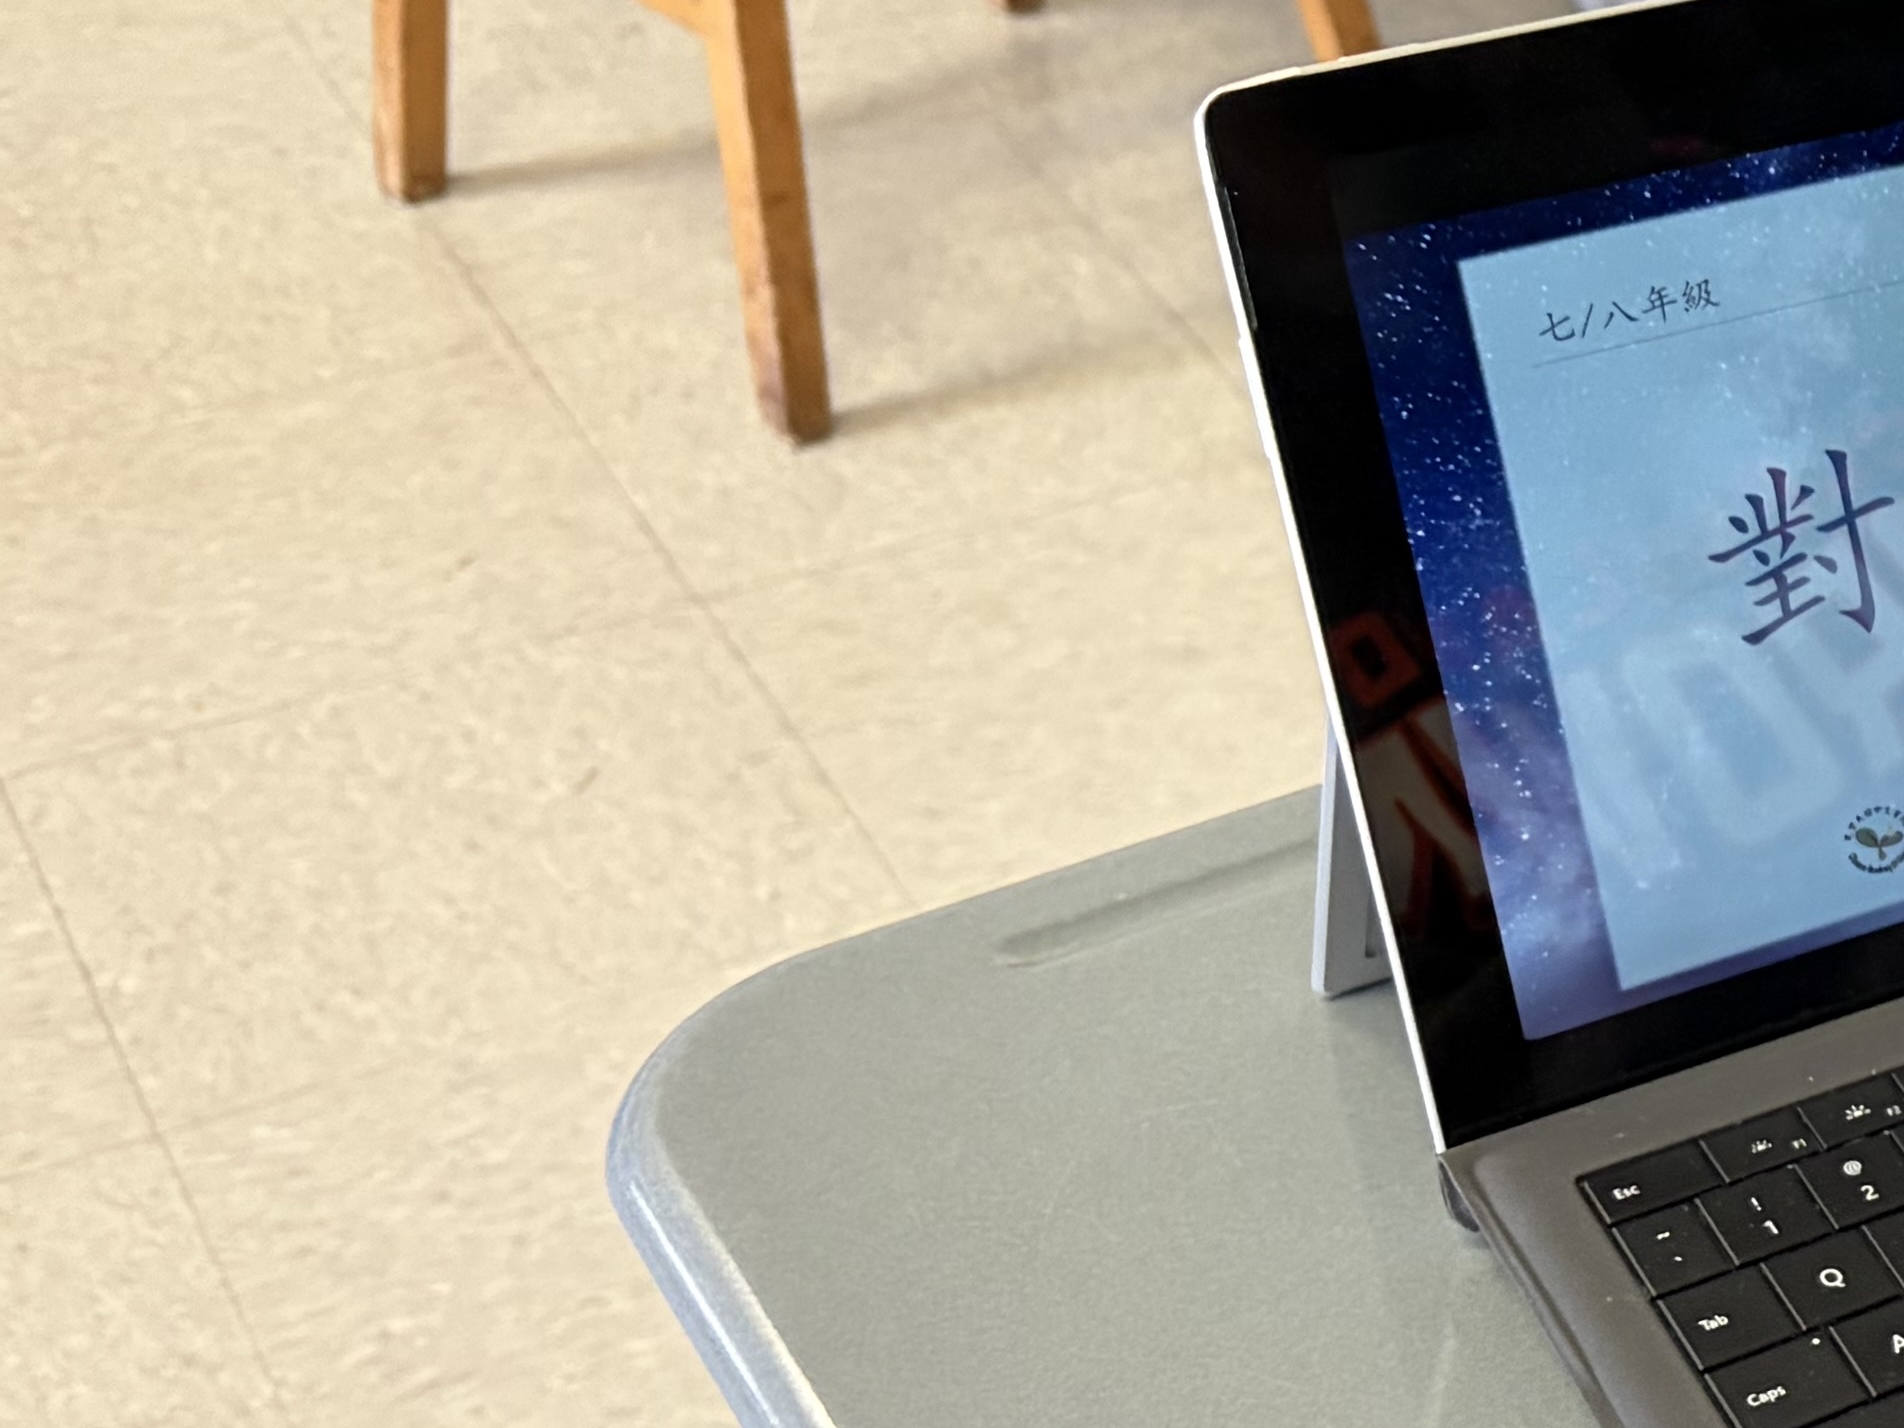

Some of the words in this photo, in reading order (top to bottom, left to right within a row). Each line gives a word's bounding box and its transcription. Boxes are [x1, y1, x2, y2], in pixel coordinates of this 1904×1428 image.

[1539, 278, 1721, 344] 七/八年級
[1612, 1185, 1640, 1200] Esc
[1763, 1220, 1779, 1235] 1
[1860, 1184, 1879, 1201] 2
[1697, 1314, 1729, 1331] Tab
[1819, 1268, 1846, 1288] Q
[1746, 1385, 1787, 1407] Caps
